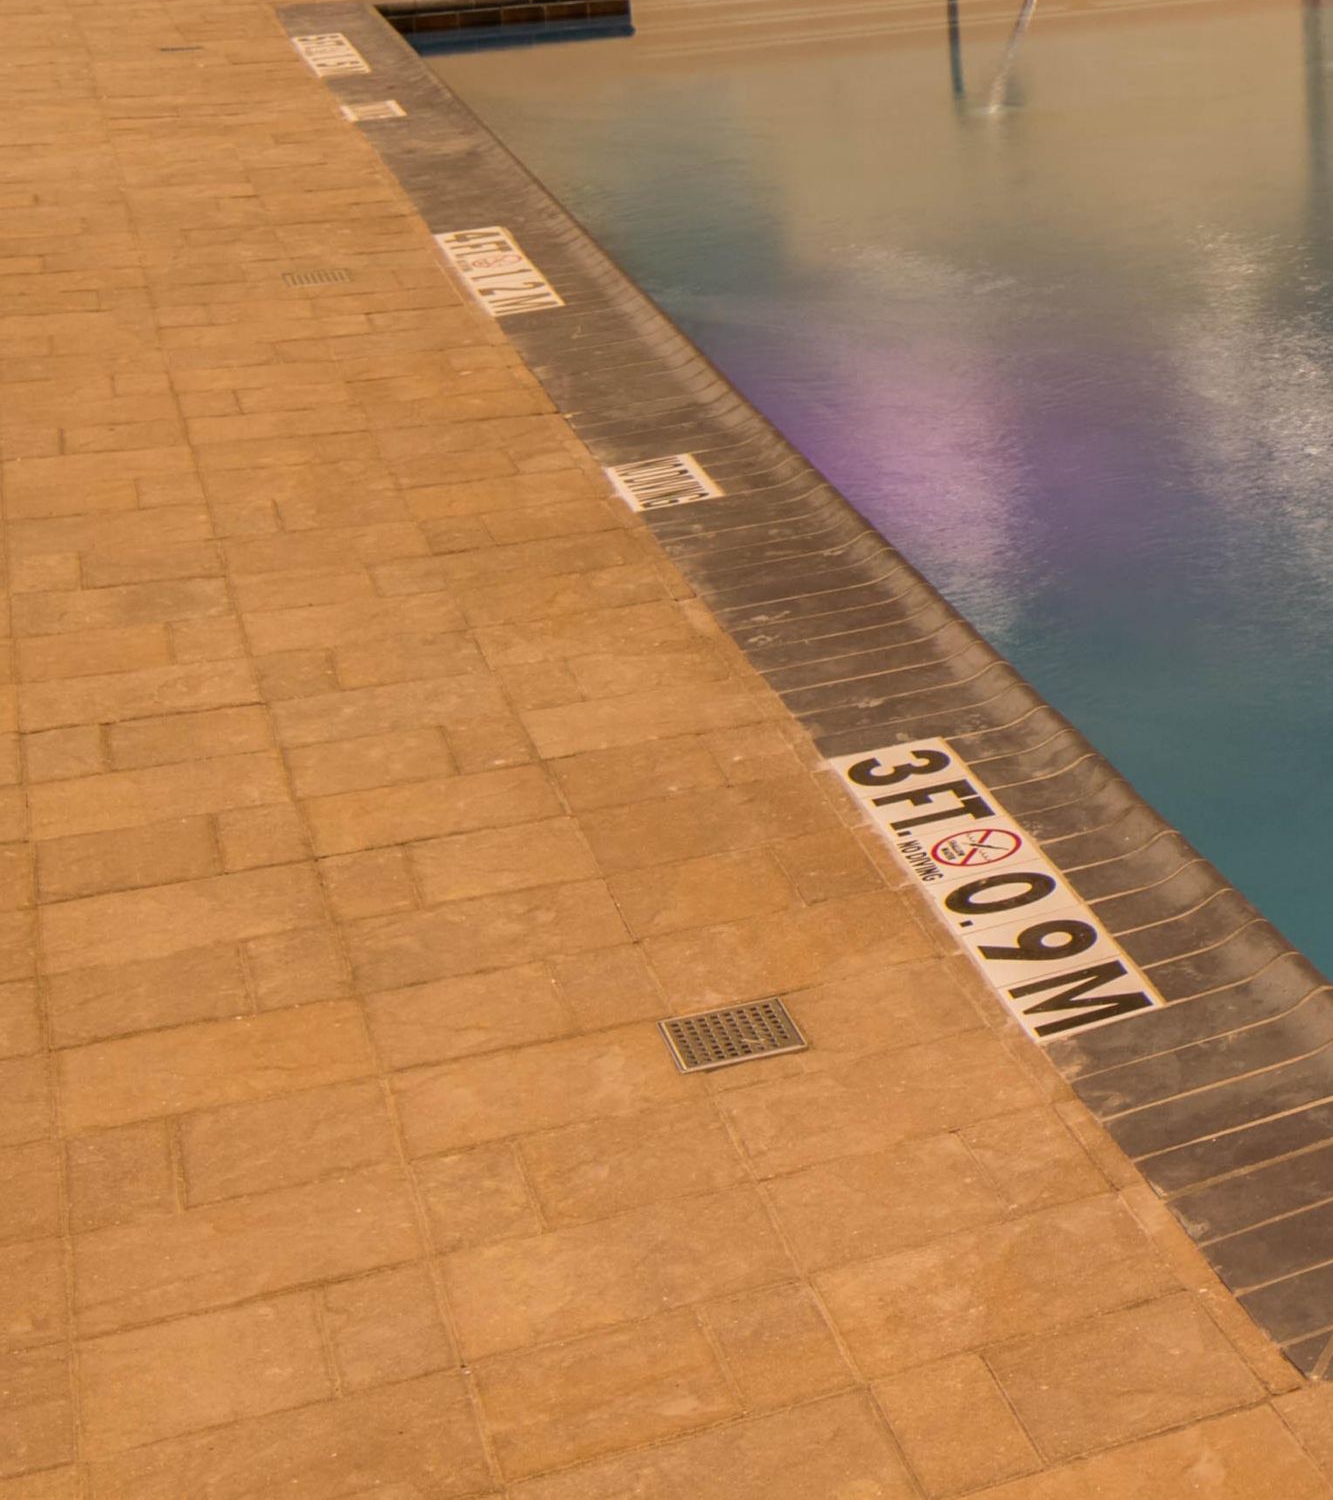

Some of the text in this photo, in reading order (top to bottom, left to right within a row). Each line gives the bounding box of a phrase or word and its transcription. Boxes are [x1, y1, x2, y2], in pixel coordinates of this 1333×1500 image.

[623, 469, 710, 509] DIVING
[896, 840, 944, 881] NO DIVING
[848, 749, 951, 786] 3
[1008, 959, 1154, 1037] M
